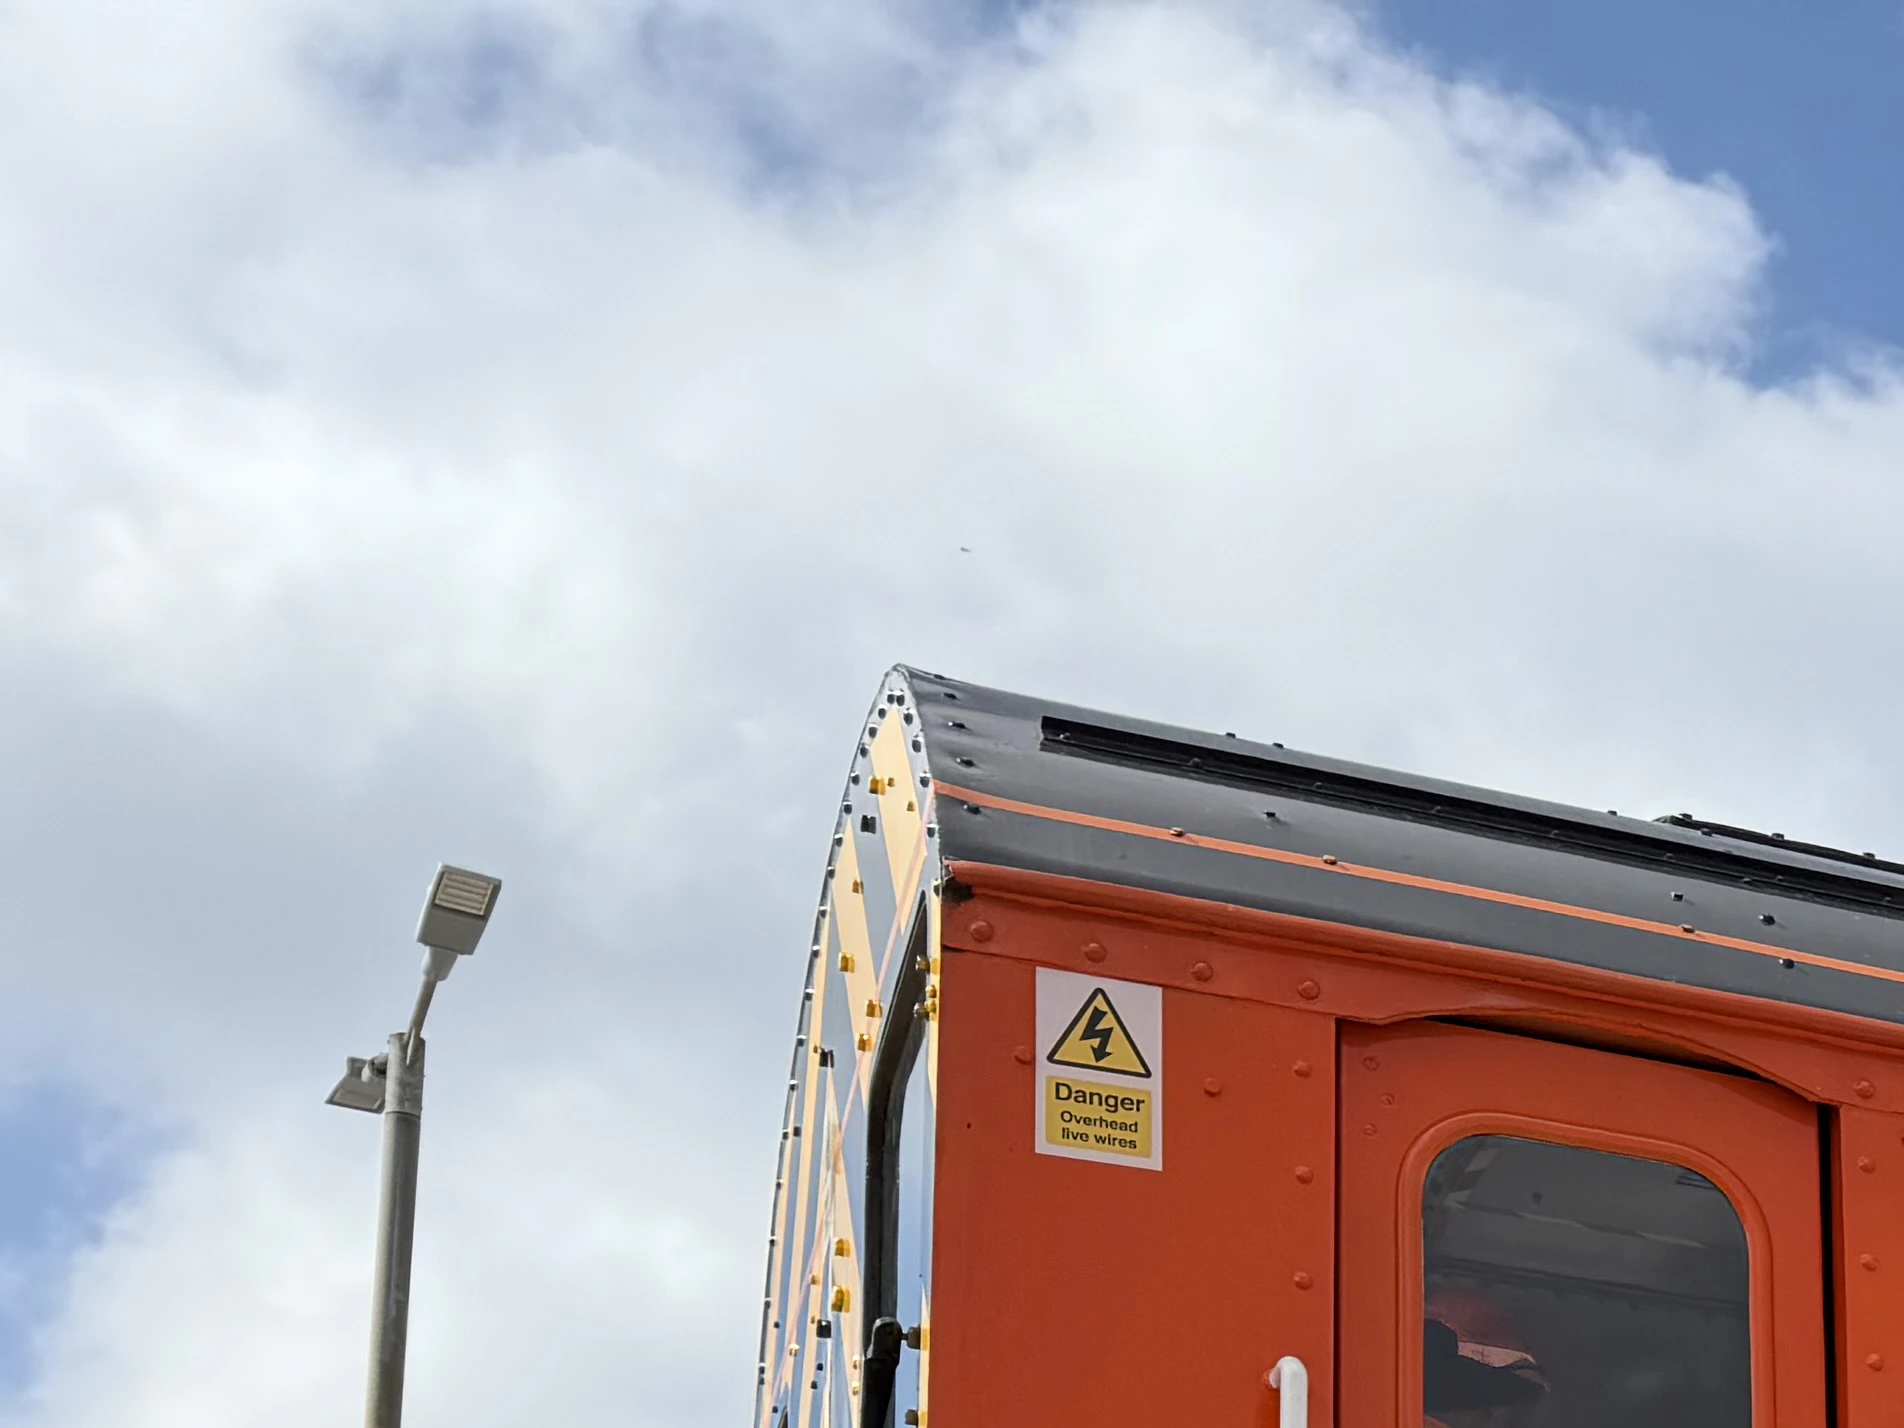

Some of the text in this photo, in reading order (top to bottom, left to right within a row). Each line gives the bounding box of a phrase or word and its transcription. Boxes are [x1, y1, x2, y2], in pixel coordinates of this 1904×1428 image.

[1054, 1082, 1145, 1112] Danger
[1060, 1110, 1138, 1133] Overhead
[1061, 1127, 1137, 1149] live wires
